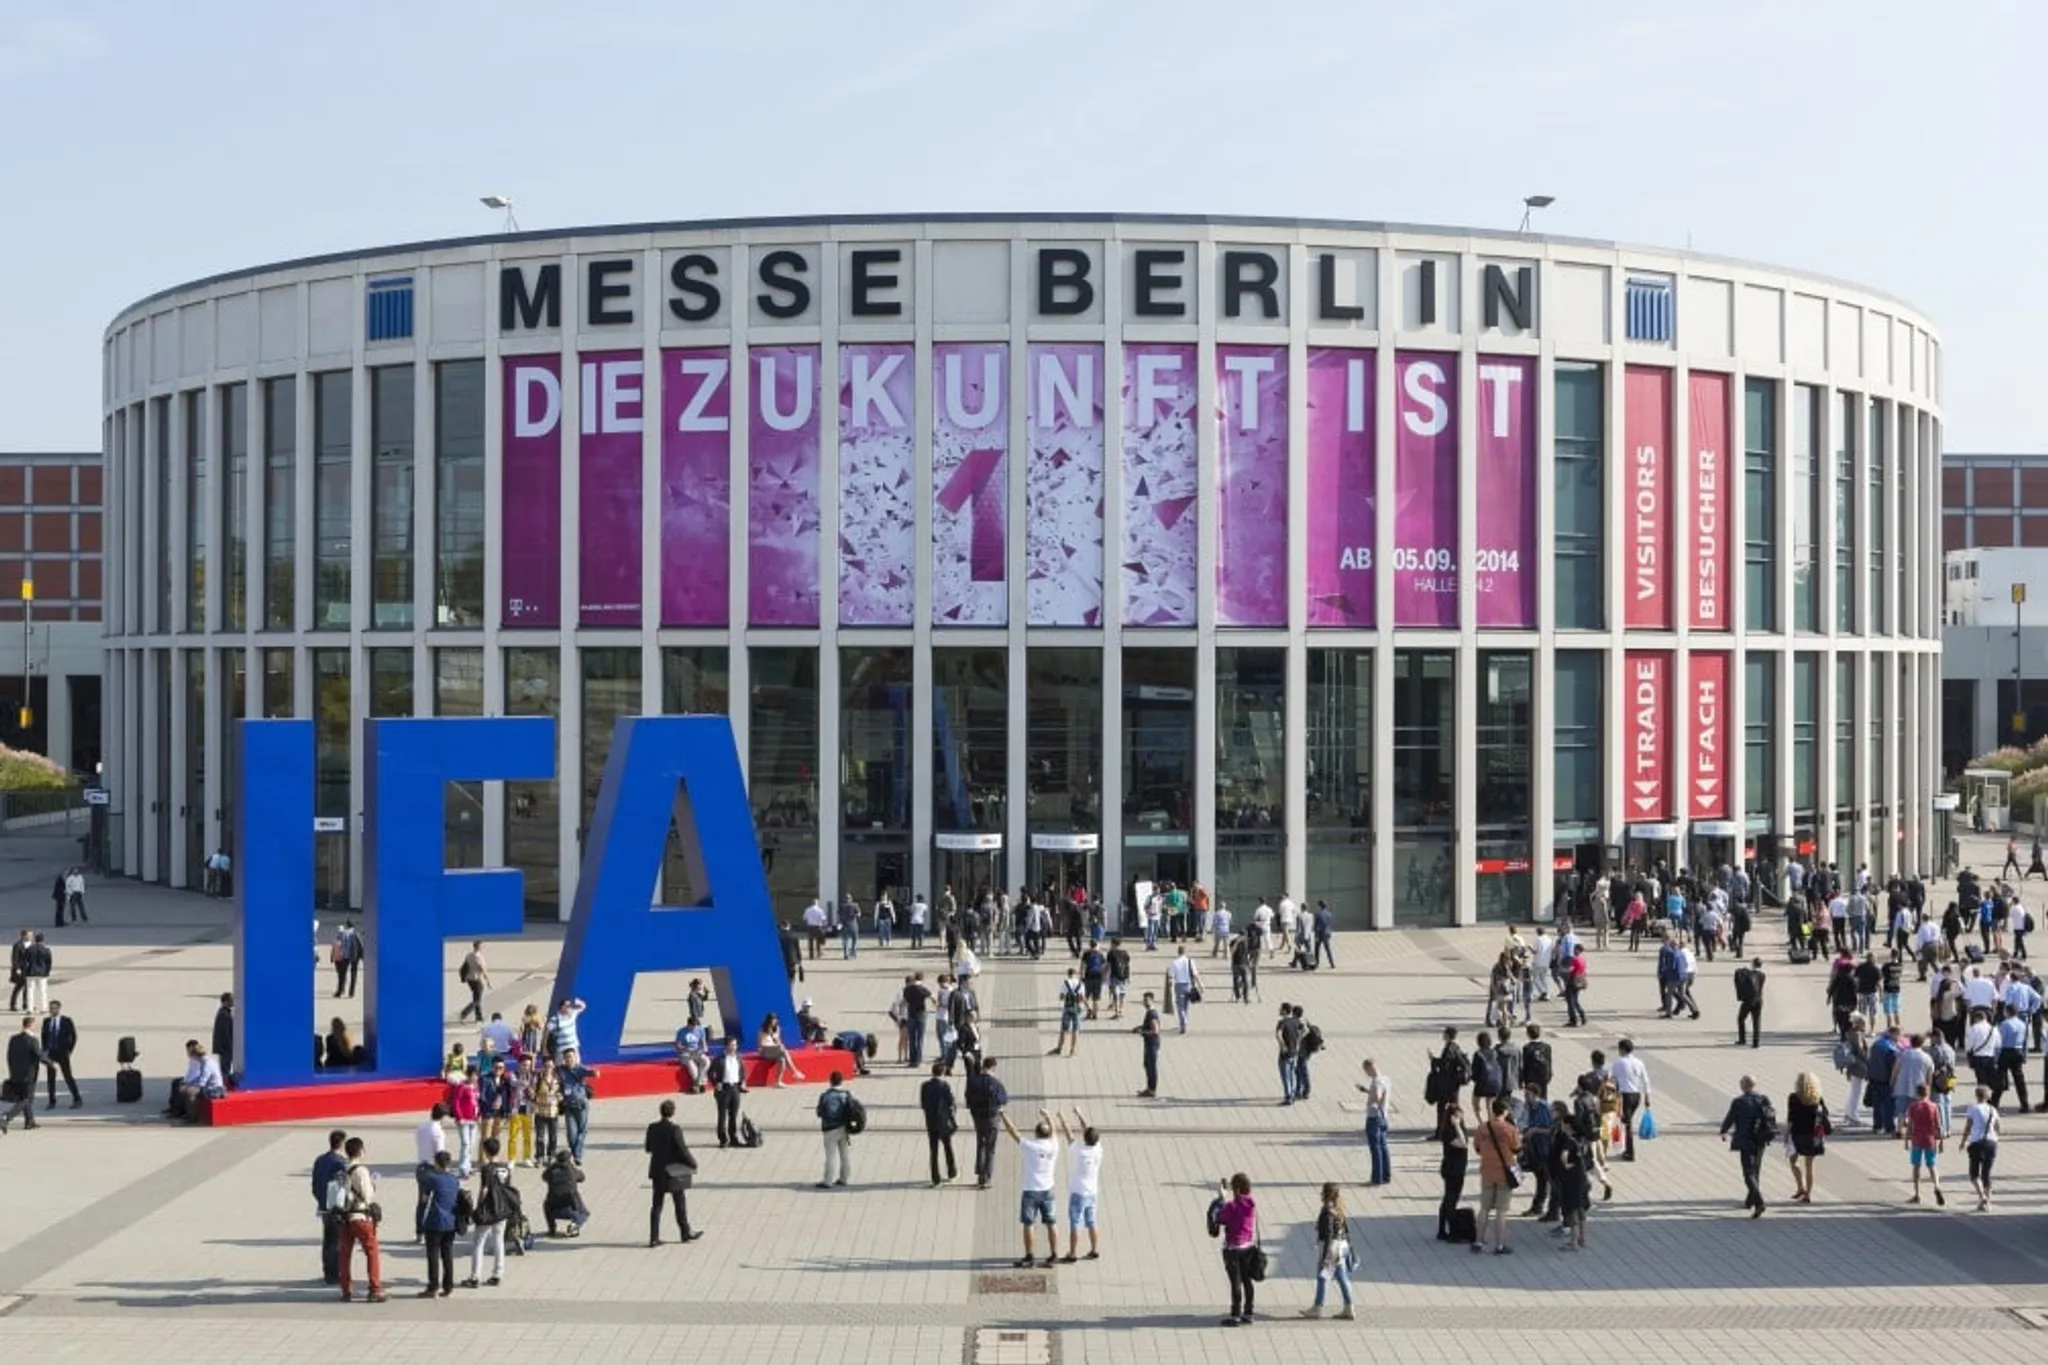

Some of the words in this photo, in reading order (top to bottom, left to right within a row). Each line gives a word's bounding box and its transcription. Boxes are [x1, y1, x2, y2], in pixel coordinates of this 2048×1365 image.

[501, 249, 902, 331] MESSE
[1038, 249, 1532, 330] BERLIN
[514, 360, 643, 438] DIE
[678, 353, 1275, 432] ZUKUNFT
[1348, 358, 1523, 438] IST
[1339, 546, 1372, 571] AB
[1392, 548, 1457, 572] 05.09.
[1473, 549, 1520, 573] 2014
[1636, 446, 1656, 600] VISITORS
[1699, 450, 1715, 619] BESUCHER
[1636, 660, 1656, 774] TRADE
[1699, 680, 1716, 772] FACH
[234, 714, 803, 1090] IFA
